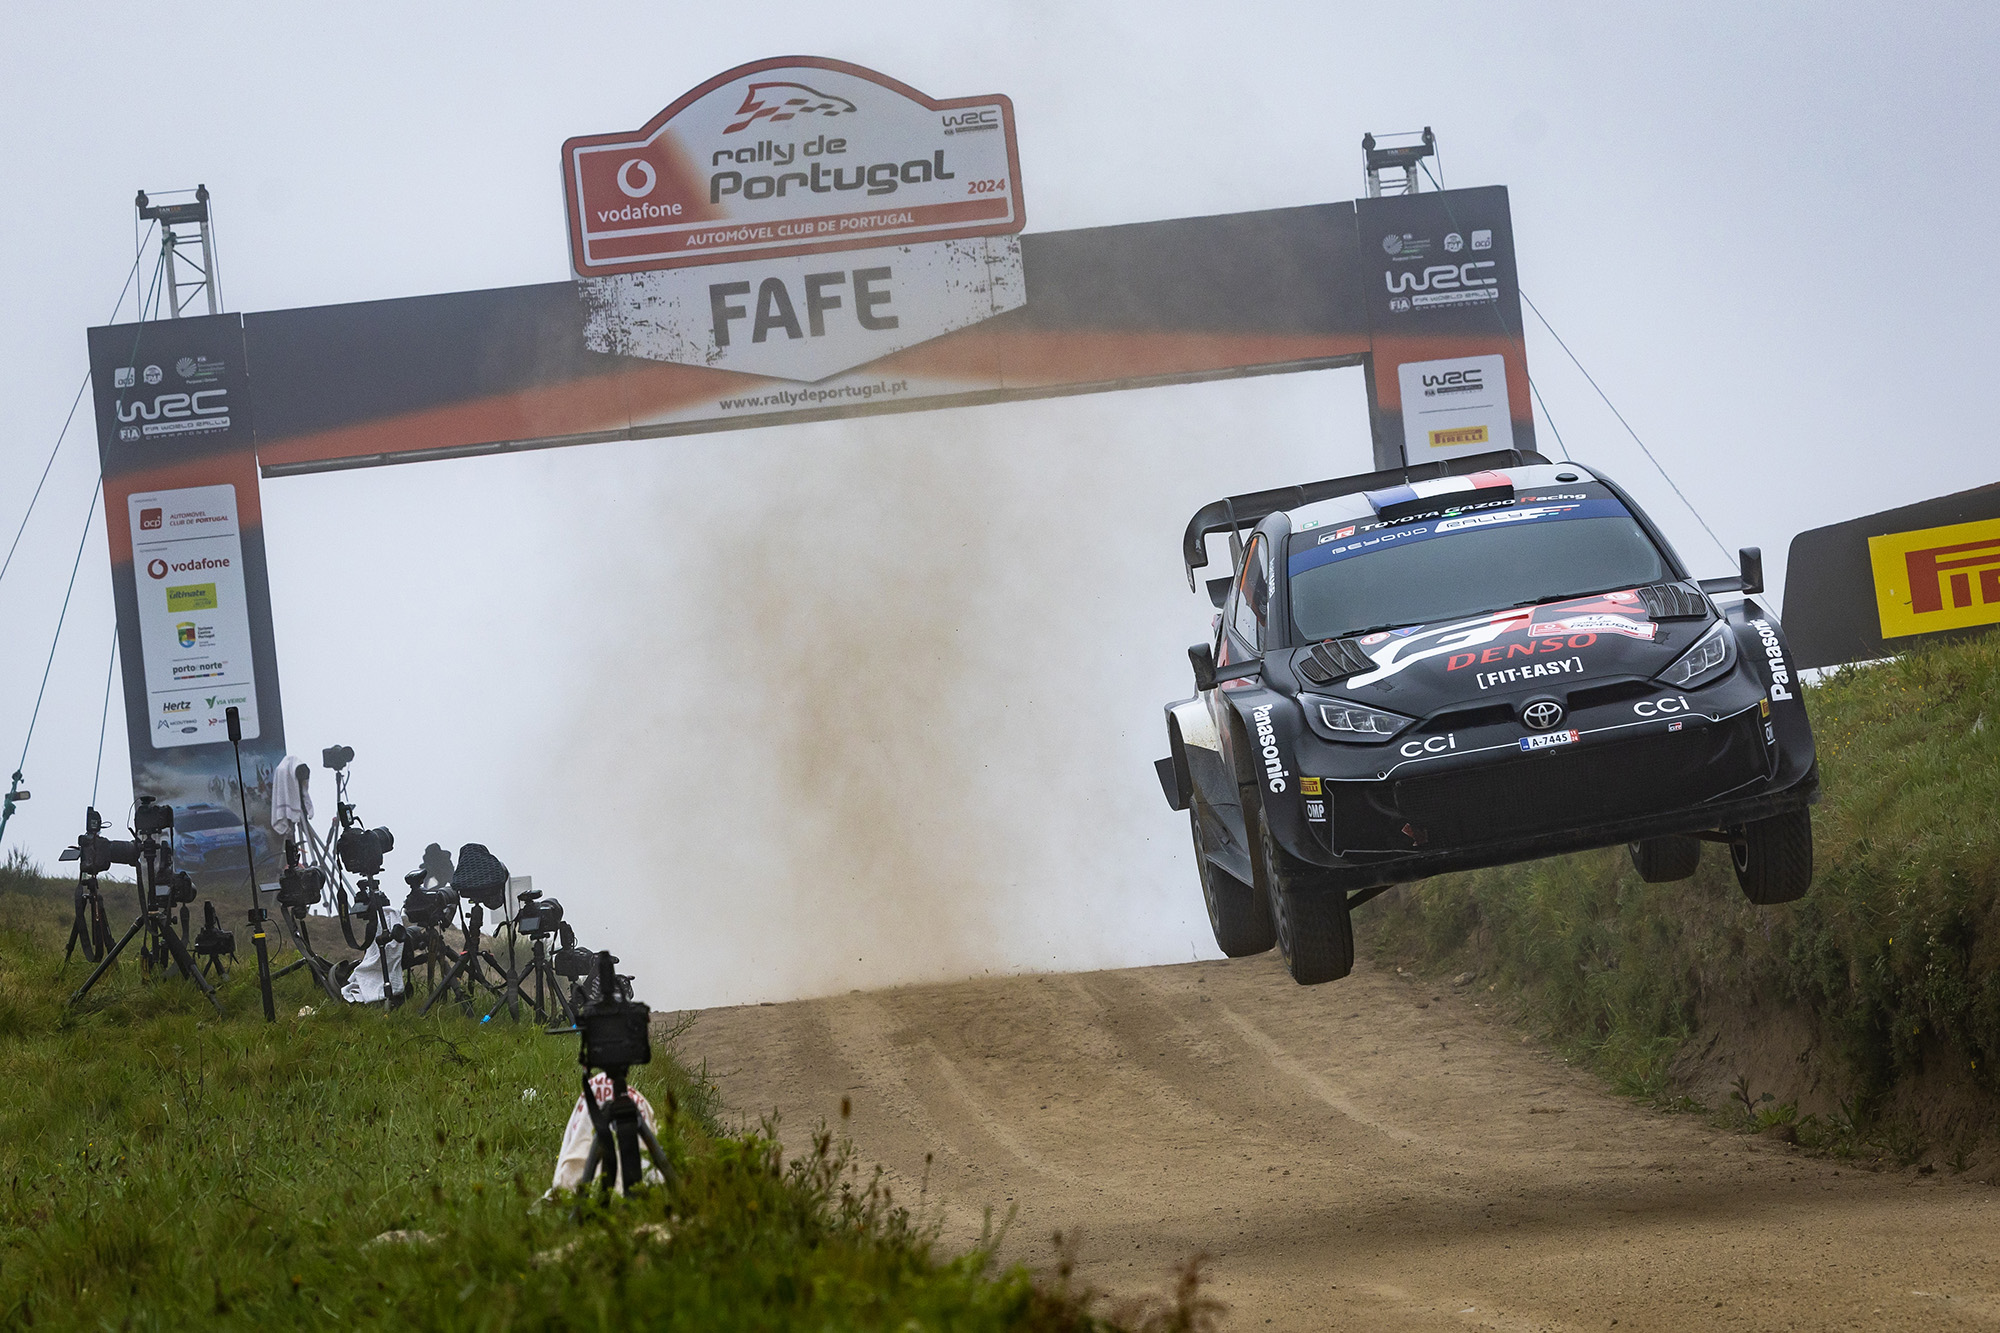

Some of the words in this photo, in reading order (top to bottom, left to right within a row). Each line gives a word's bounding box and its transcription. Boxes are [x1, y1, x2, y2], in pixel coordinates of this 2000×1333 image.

[712, 140, 795, 167] rally
[802, 135, 848, 158] de
[709, 149, 955, 205] Portugal
[966, 178, 1006, 195] 2024
[597, 202, 683, 223] vodafone
[686, 226, 774, 246] AUTOMÓVEL
[777, 220, 815, 238] CLUB
[817, 218, 838, 233] DE
[839, 212, 915, 231] PORTUGAL
[1385, 260, 1498, 293] WRC
[708, 265, 900, 347] FAFE
[1390, 300, 1410, 311] FIA
[1422, 369, 1482, 387] WRC
[116, 388, 229, 422] WRC
[718, 379, 909, 410] www.rallydeportugal.pt
[120, 428, 140, 440] FIA
[161, 421, 194, 431] WORLD
[196, 418, 228, 428] RALLY
[1434, 428, 1483, 445] PIRELLI
[169, 519, 185, 527] CLUB
[195, 515, 229, 524] PORTUGAL
[1360, 510, 1440, 531] TOYOTA
[1444, 499, 1516, 514] GAZOO
[1520, 493, 1587, 503] Racing
[1331, 527, 1428, 555] BEYOND
[1446, 512, 1523, 528] RALLY
[171, 557, 230, 573] vodafone
[1446, 633, 1598, 672] DENSO
[172, 664, 196, 675] porto
[199, 661, 223, 670] norte
[1476, 656, 1583, 690] [FIT-EASY]
[162, 700, 192, 711] Hertz
[1252, 703, 1289, 794] Panasonic
[1532, 733, 1568, 747] A-7445
[1307, 804, 1325, 818] OMP
